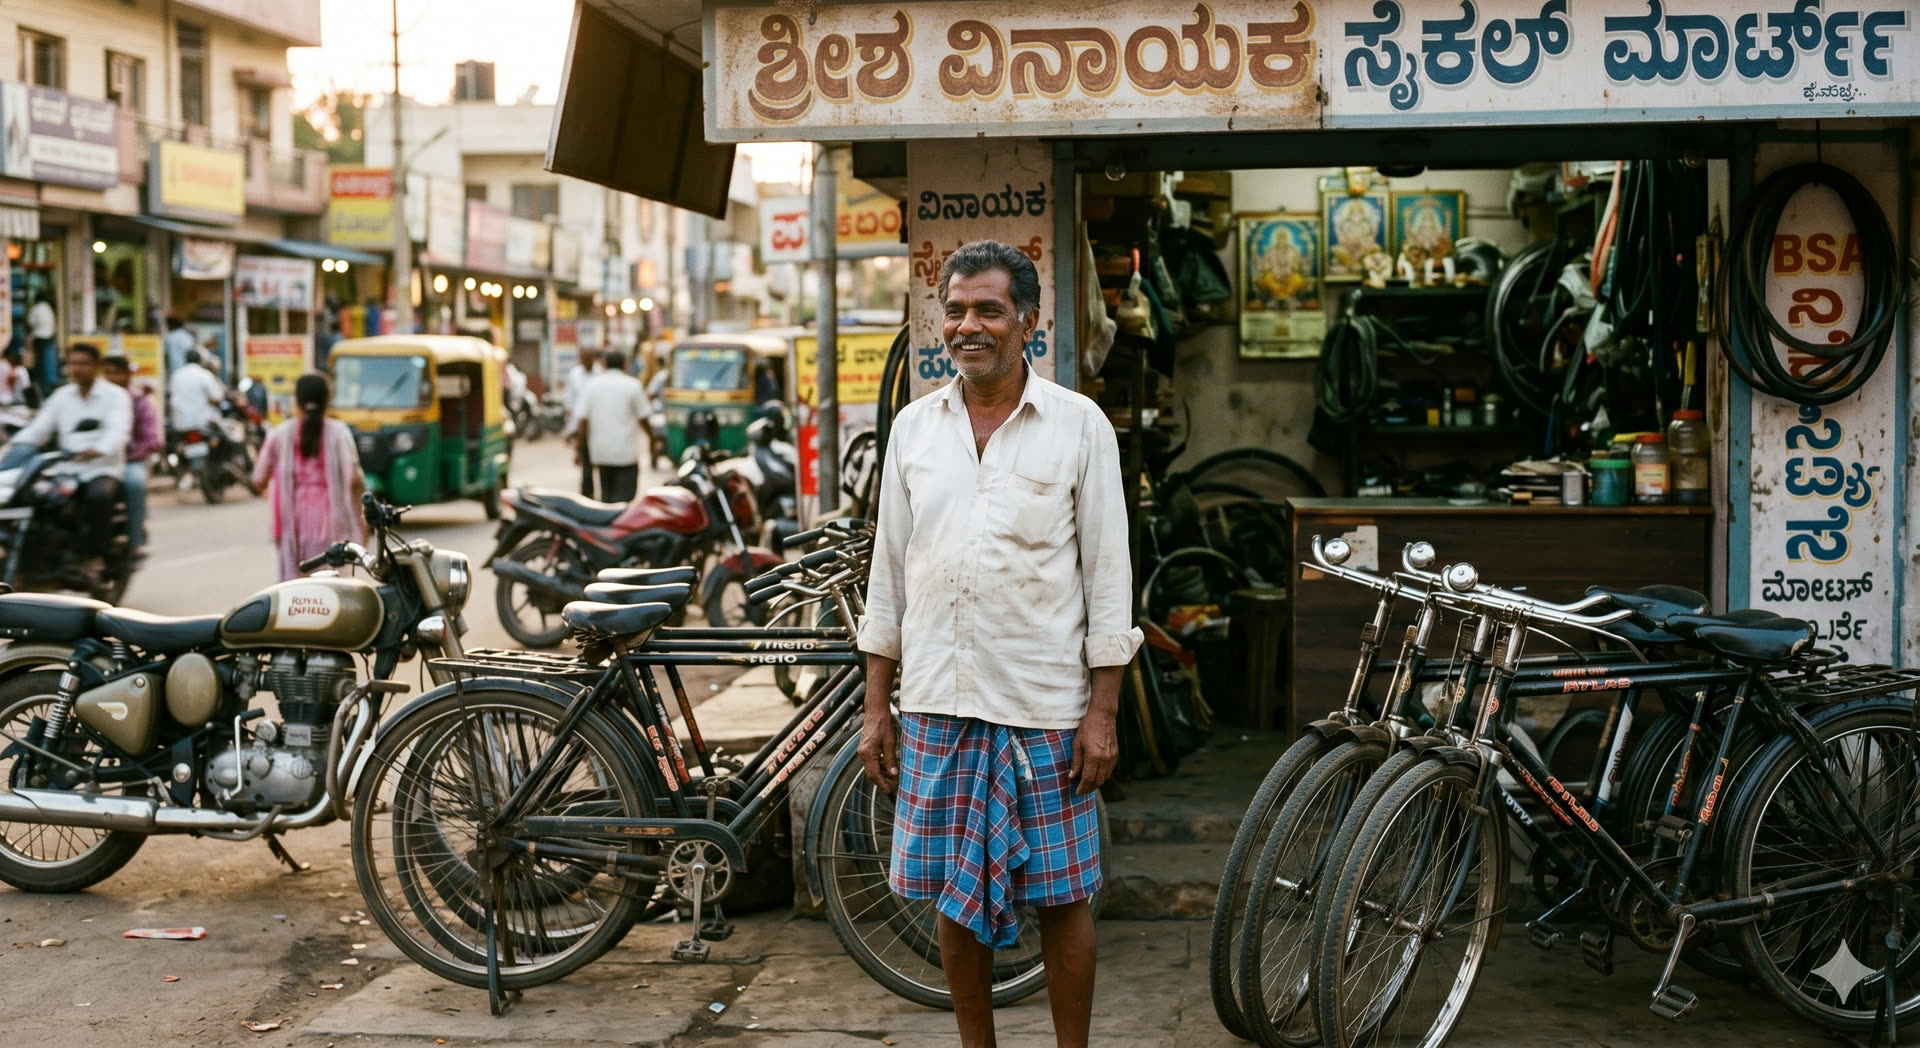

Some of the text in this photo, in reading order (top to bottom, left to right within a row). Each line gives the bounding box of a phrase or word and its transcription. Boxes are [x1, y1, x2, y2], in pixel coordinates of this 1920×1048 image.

[938, 2, 1314, 101] ವಿನಾಯಕ
[1343, 0, 1573, 110] ಸೈಕಲ್
[917, 181, 1047, 220] ವಿನಾಯಕ
[1773, 232, 1865, 275] BSA
[288, 606, 331, 616] ENFIELD
[291, 596, 325, 605] ROYAL
